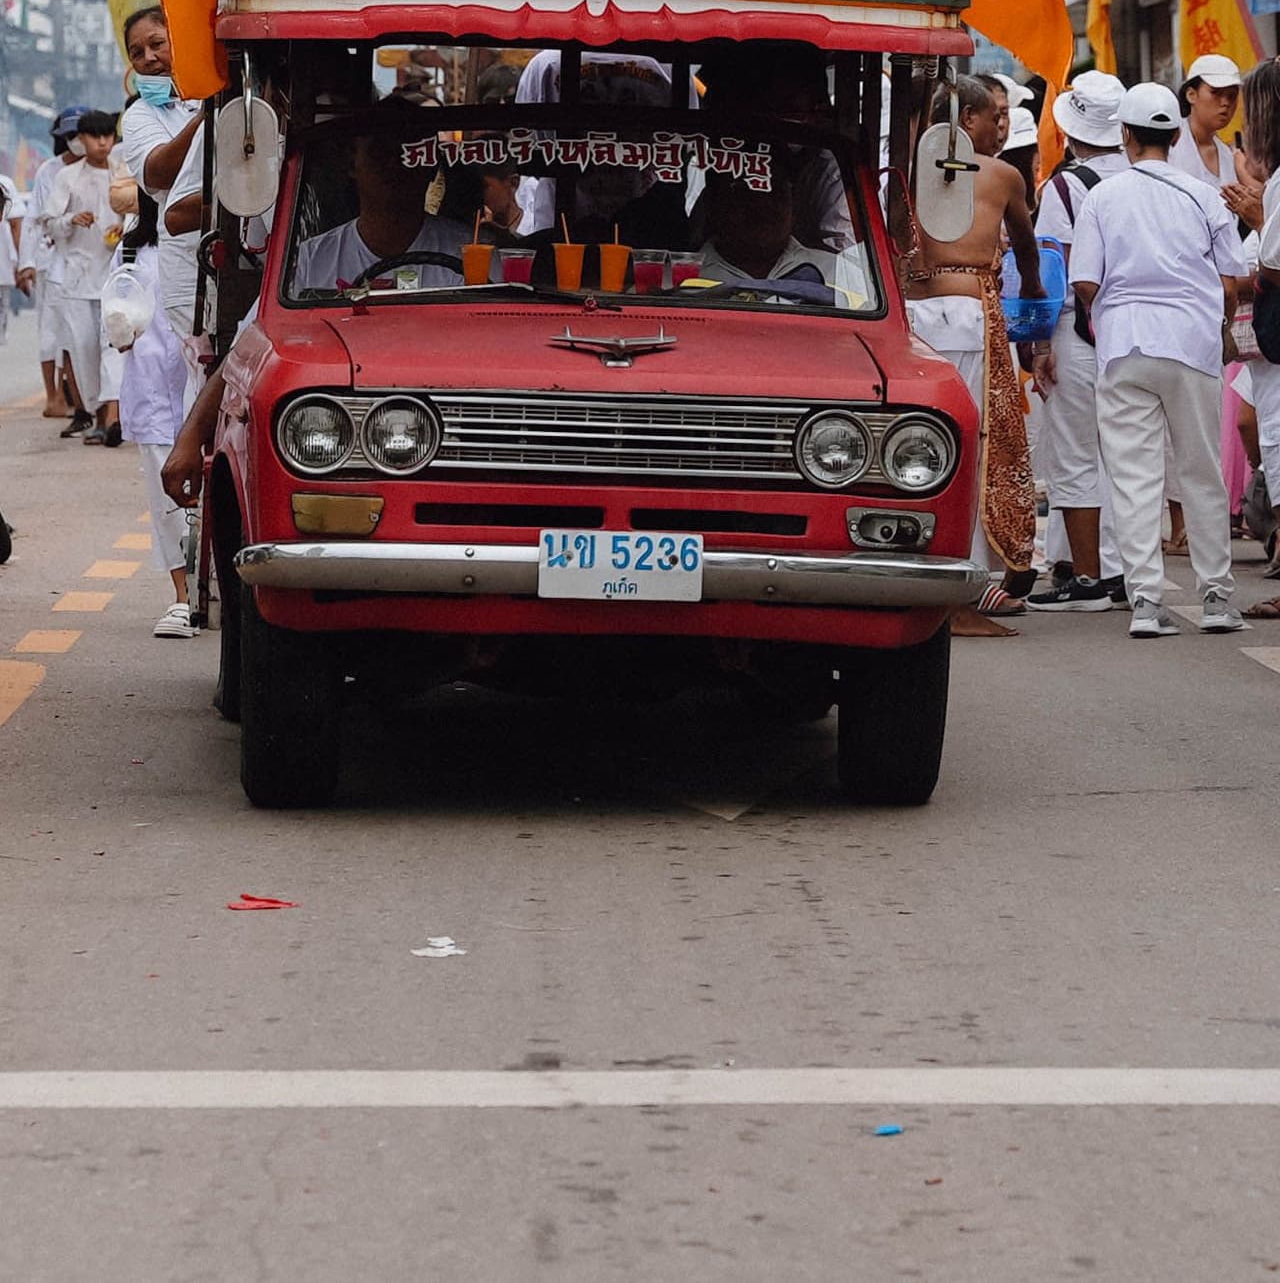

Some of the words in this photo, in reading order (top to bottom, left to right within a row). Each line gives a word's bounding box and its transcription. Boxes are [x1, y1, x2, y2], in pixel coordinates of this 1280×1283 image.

[543, 532, 597, 569] นข
[611, 535, 699, 572] 5236
[602, 576, 638, 599] ภูเก็ต
